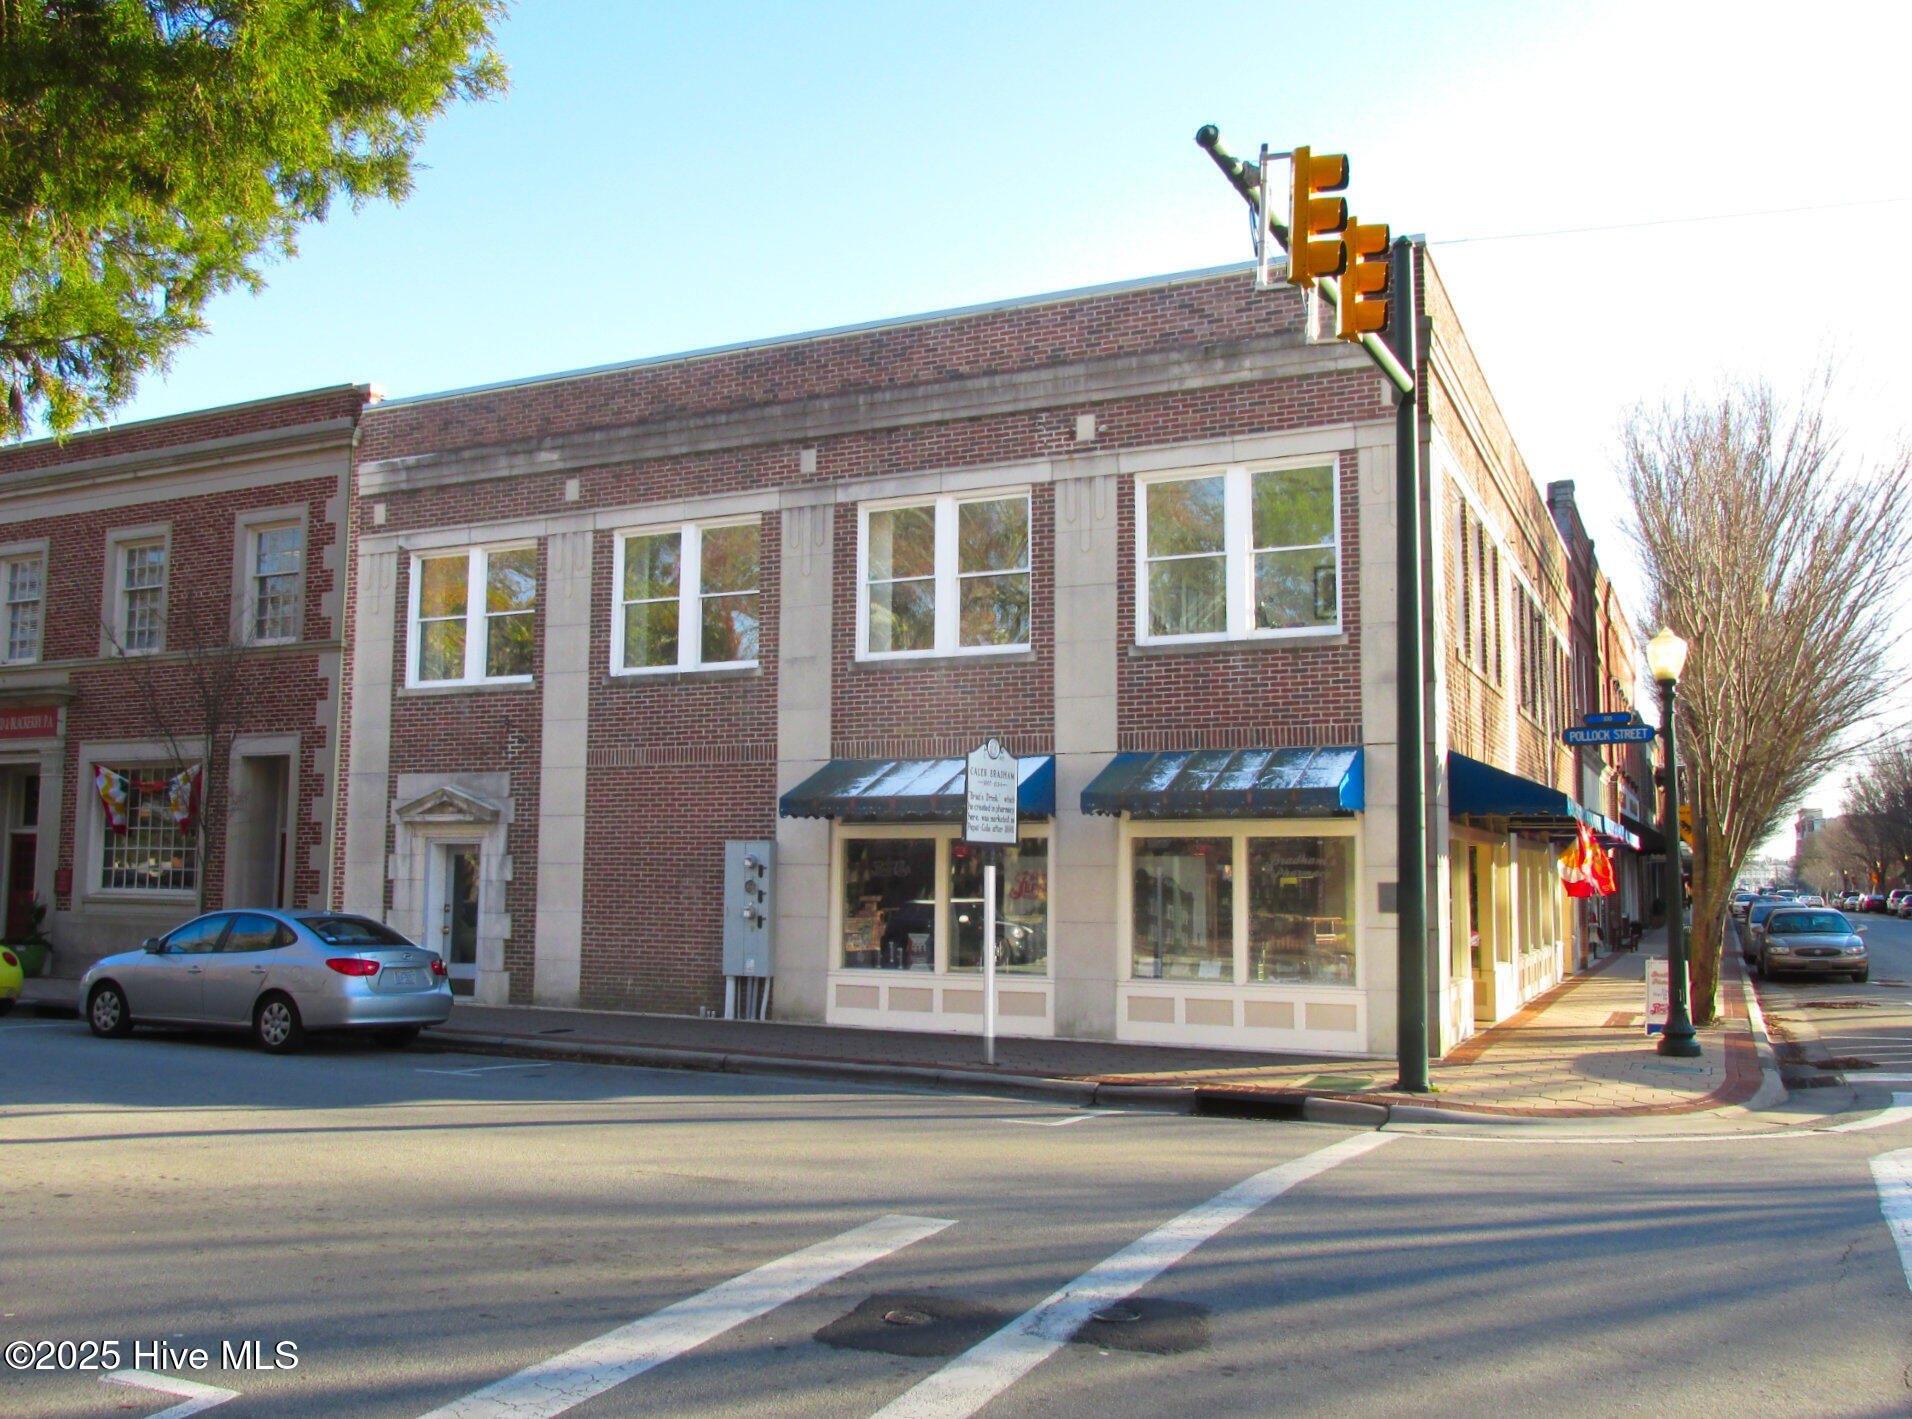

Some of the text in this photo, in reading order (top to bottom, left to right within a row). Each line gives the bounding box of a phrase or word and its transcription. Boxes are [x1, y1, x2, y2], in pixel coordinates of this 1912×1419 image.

[1569, 728, 1648, 742] POLLOCK STREET
[970, 767, 1015, 780] CALEB BRADHAM
